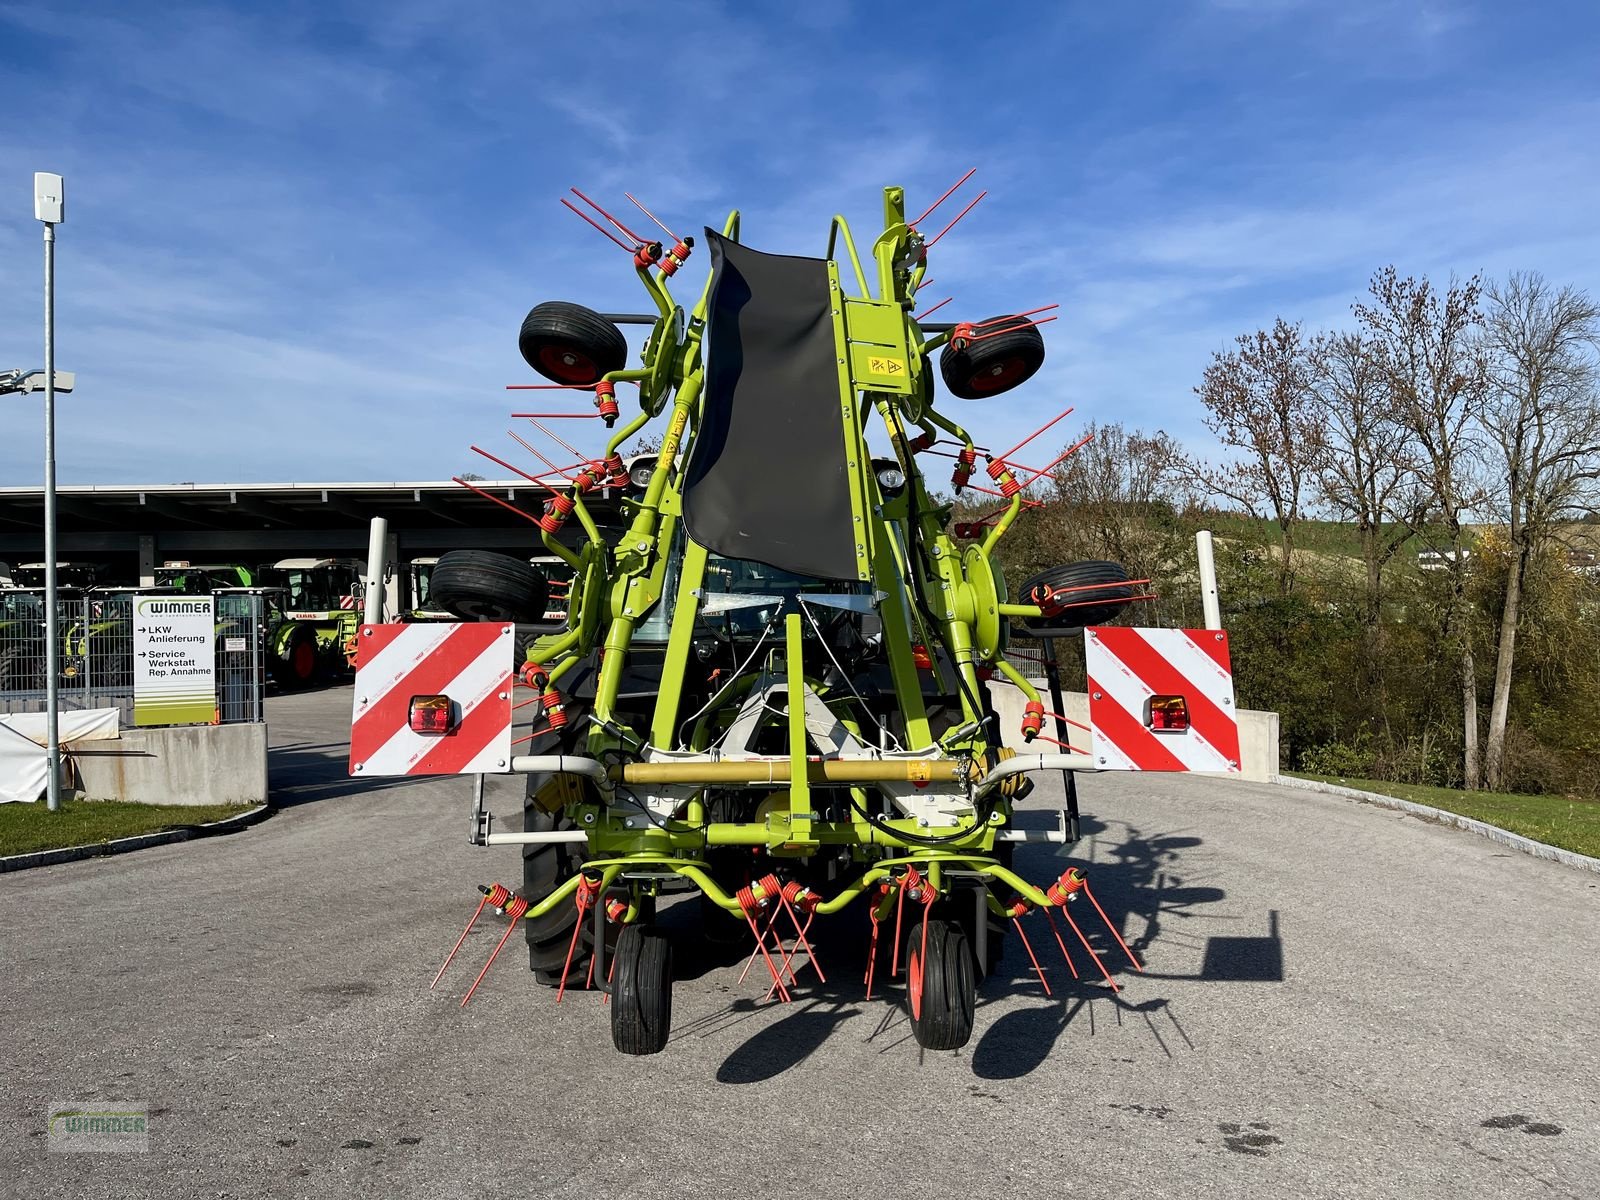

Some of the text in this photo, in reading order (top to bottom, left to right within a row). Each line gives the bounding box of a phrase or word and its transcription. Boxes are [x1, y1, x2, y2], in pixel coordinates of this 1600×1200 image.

[150, 603, 211, 613] WIMMER
[148, 626, 172, 634] LKW
[148, 635, 206, 644] Anlieferung
[148, 650, 186, 659] Service
[148, 659, 196, 668] Werkstatt
[148, 667, 212, 678] Rep. Annahme
